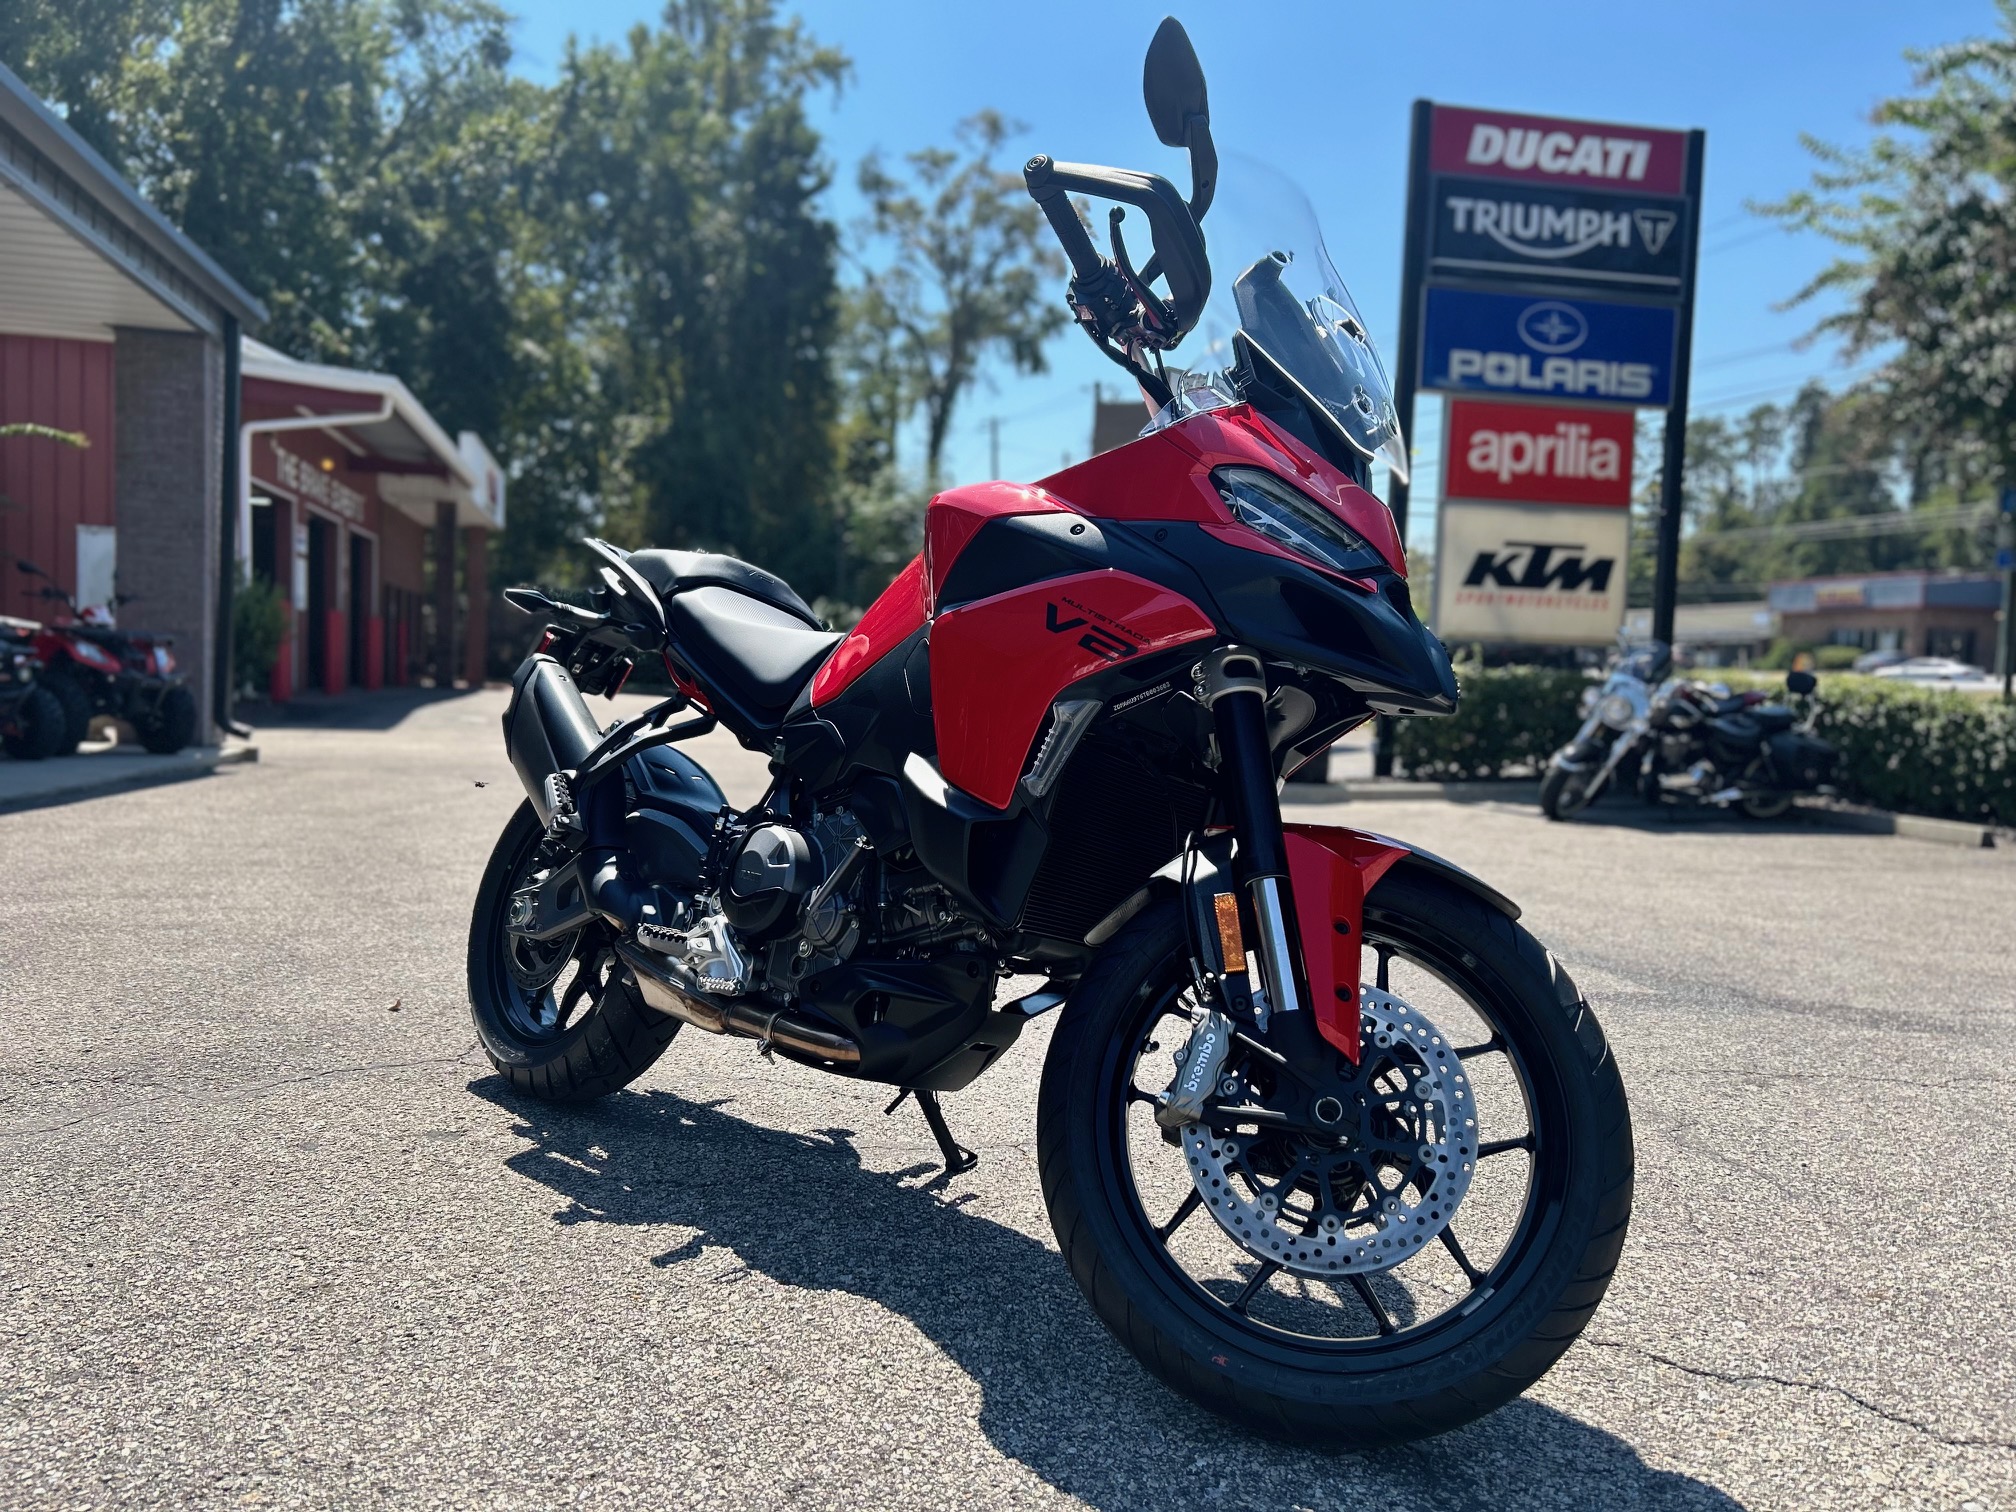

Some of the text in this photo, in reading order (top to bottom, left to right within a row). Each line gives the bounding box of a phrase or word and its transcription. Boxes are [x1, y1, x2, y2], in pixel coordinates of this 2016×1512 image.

[1466, 123, 1652, 181] DUCATI
[1447, 196, 1632, 258] TRIUMPH
[1449, 348, 1653, 398] POLARIS
[1466, 421, 1621, 484] aprilia
[1463, 540, 1616, 594] KTM
[1045, 602, 1139, 662] V2
[1061, 596, 1151, 645] MULTISTRADA
[1183, 1032, 1216, 1093] brembo
